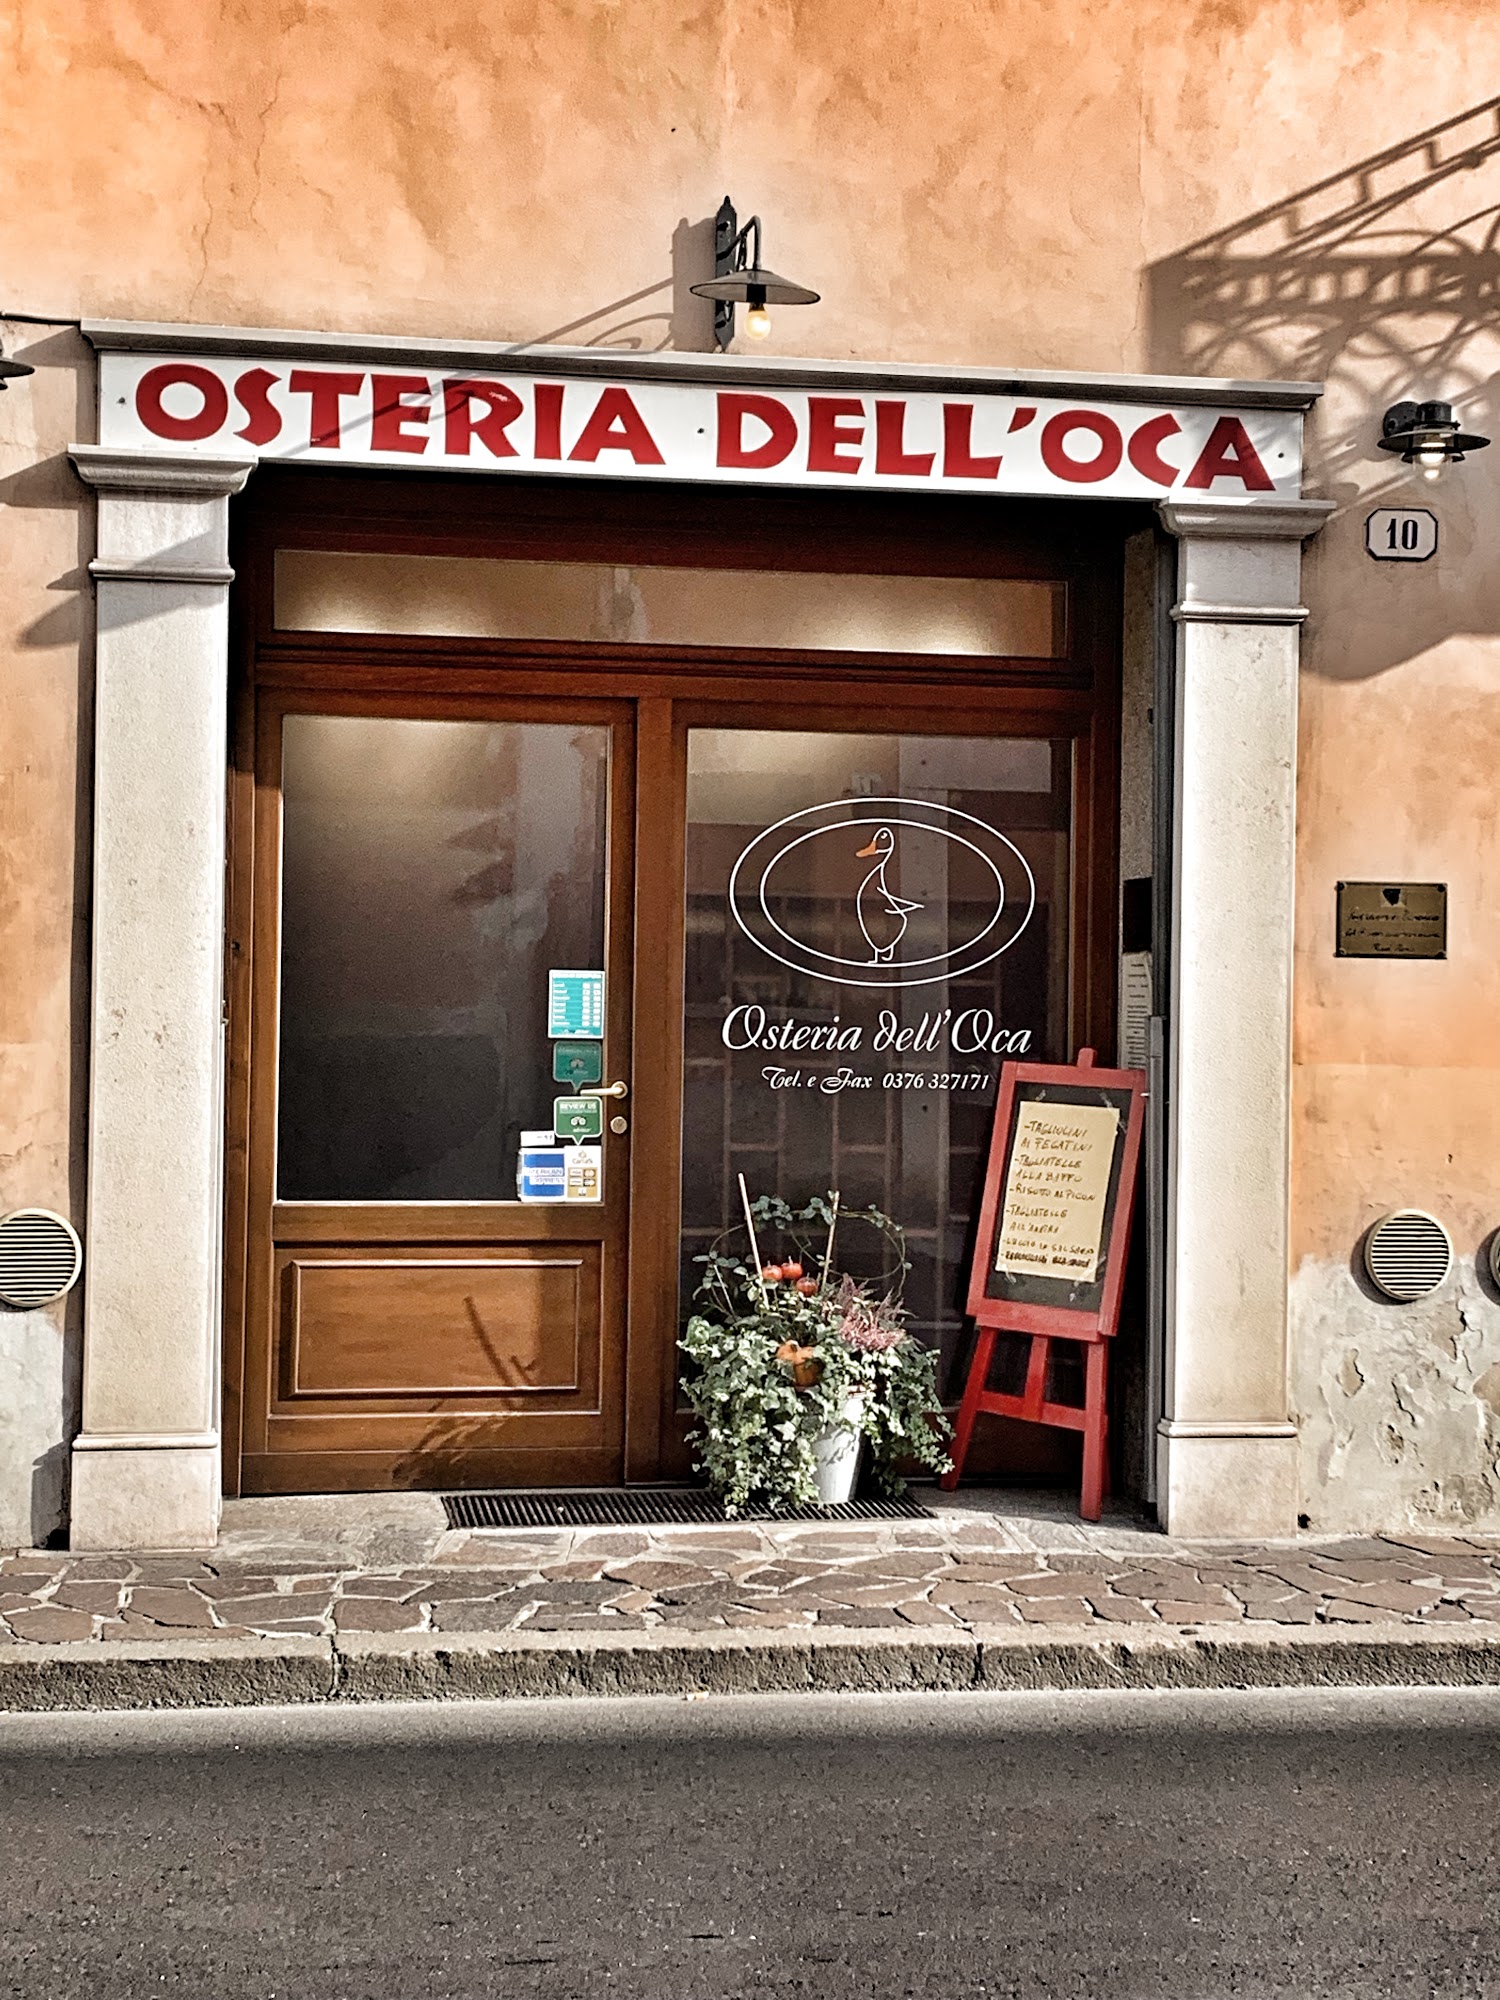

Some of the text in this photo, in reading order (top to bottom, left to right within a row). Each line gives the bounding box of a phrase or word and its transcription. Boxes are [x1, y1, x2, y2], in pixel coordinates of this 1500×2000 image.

[136, 363, 1276, 491] OSTERIA DELL'OCA
[1387, 518, 1418, 550] 10
[721, 1004, 1032, 1053] Osteria dell'Oca
[761, 1066, 989, 1094] Tel. e Fax 0376 327171
